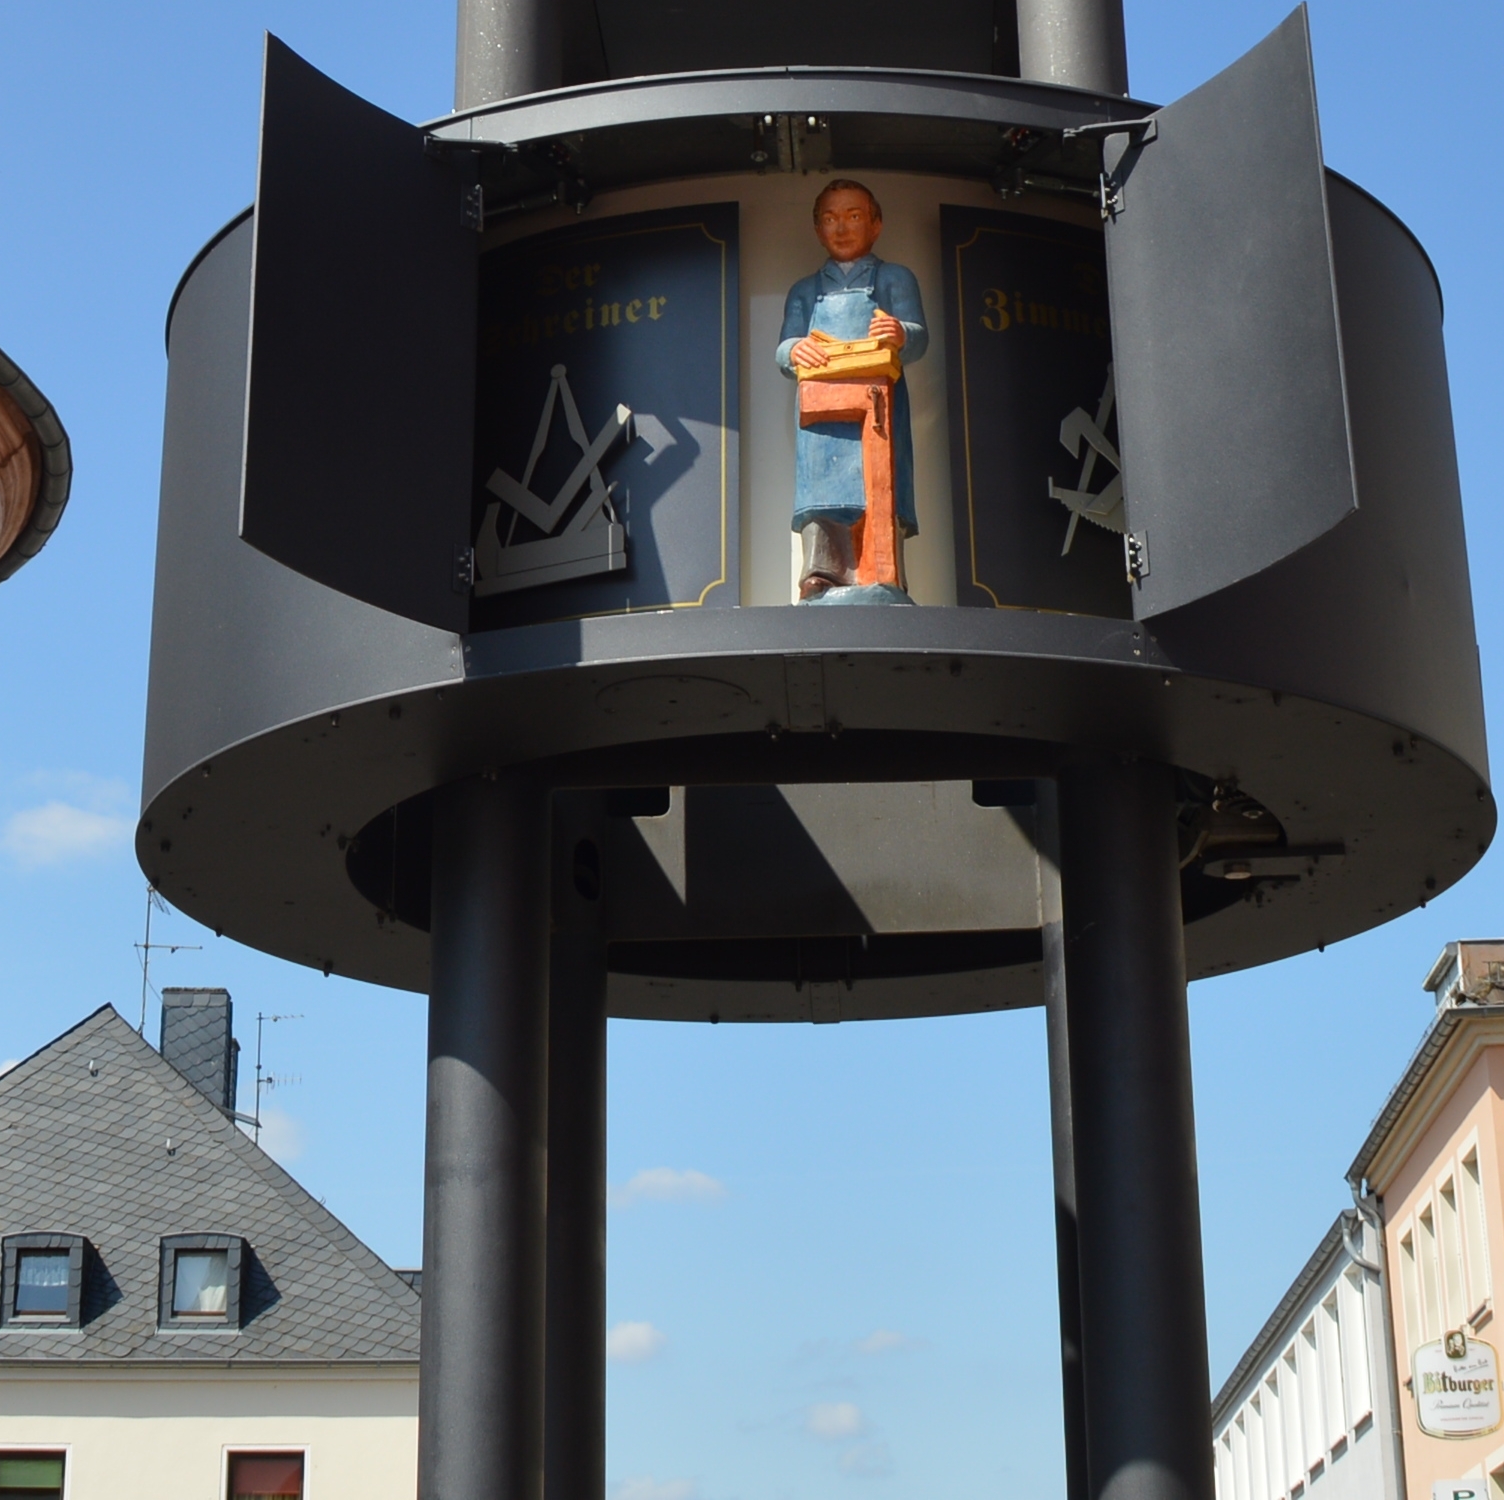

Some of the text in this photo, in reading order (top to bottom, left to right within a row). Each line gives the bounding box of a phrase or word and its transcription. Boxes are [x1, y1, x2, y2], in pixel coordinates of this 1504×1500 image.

[532, 262, 602, 297] Der
[481, 295, 668, 353] Schreiner
[978, 287, 1108, 340] Zimme
[1422, 1371, 1495, 1395] Bitburger
